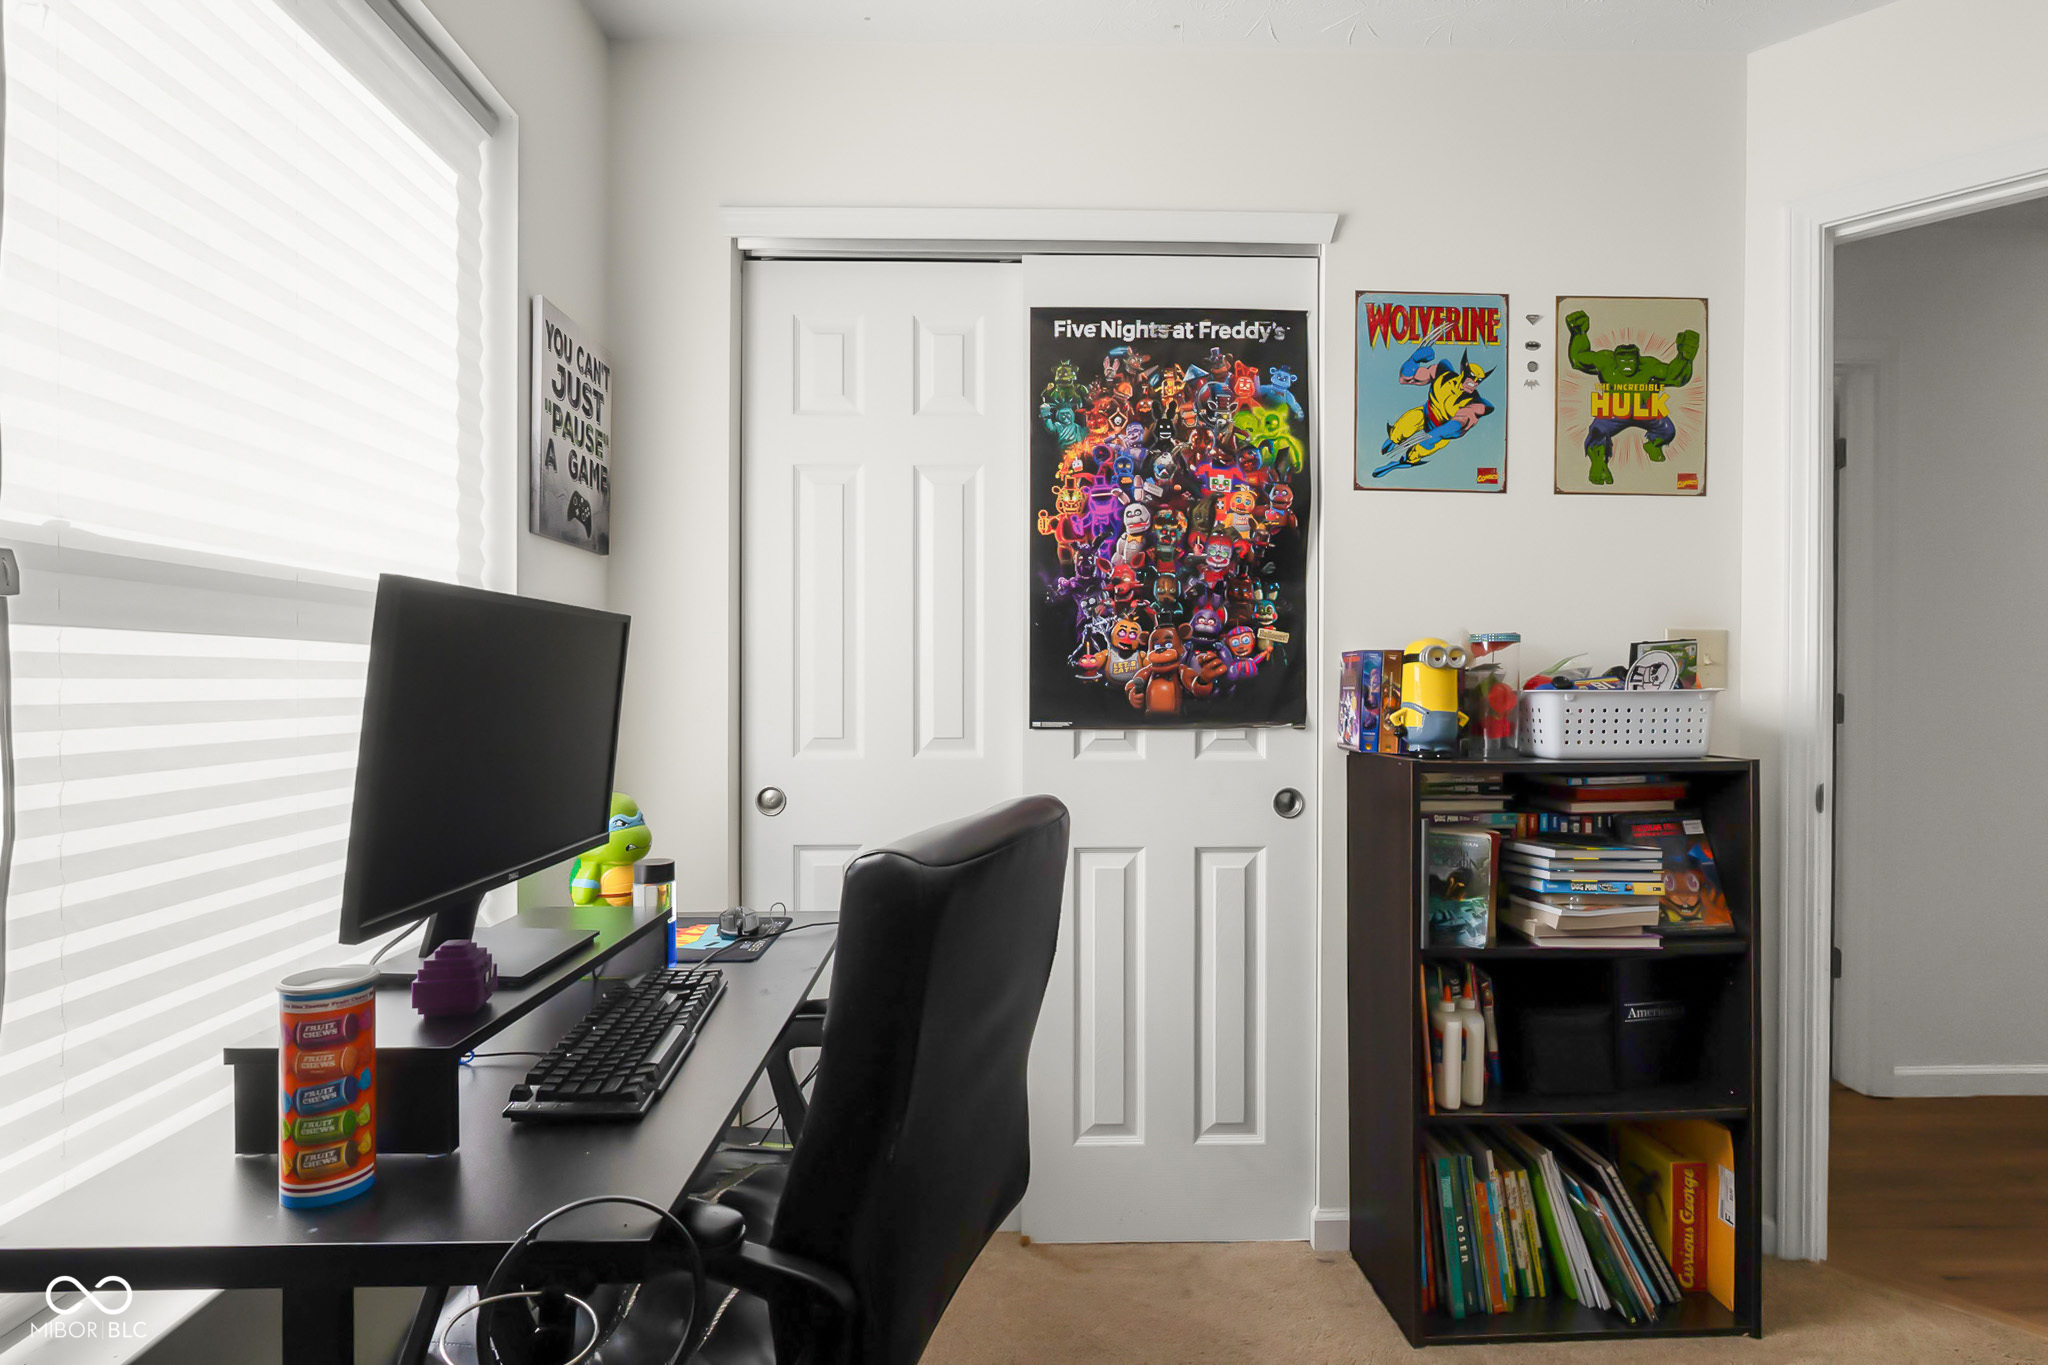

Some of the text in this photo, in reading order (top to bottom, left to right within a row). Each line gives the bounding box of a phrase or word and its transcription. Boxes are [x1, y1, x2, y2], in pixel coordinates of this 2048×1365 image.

[1054, 320, 1286, 343] Five Nights at Freddy's
[1365, 303, 1501, 350] WOLVERINE
[545, 320, 610, 392] YOU CAN'T
[1594, 383, 1665, 391] THE INCREDIBLE
[551, 364, 604, 426] JUST
[1591, 392, 1670, 418] HULK
[545, 438, 608, 494] A GAME
[1570, 882, 1584, 891] DOG
[1584, 883, 1598, 891] MAN
[303, 1028, 338, 1038] CHEWS
[305, 1022, 336, 1032] FRUIT
[303, 1054, 335, 1062] FRUIT
[301, 1061, 336, 1069] CHEWS
[304, 1086, 335, 1097] FRUIT
[303, 1092, 337, 1105] CHEWS
[303, 1119, 334, 1128] FRUIT
[301, 1126, 335, 1135] CHEWS
[304, 1150, 336, 1162] FRUIT
[303, 1157, 338, 1168] CHEWS
[1725, 1213, 1733, 1225] F
[1678, 1168, 1700, 1289] Curious George
[1455, 1216, 1469, 1264] LOSER
